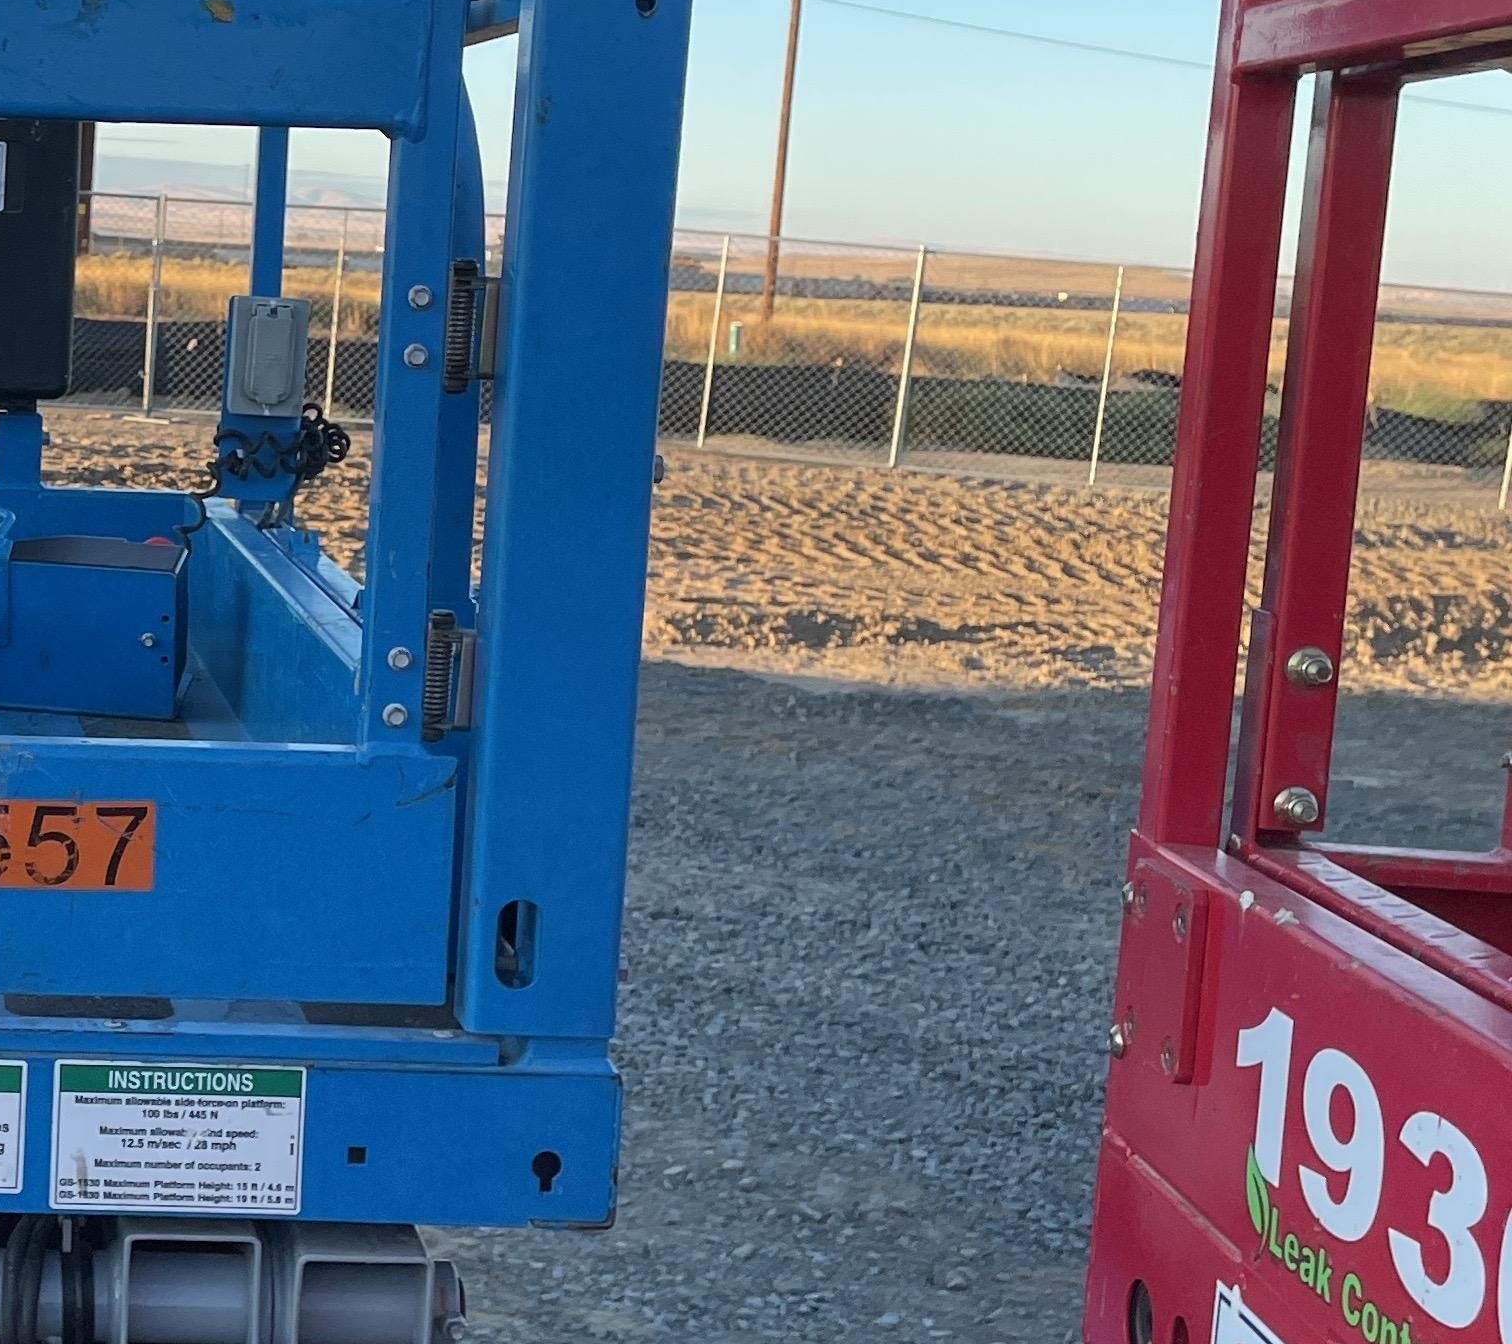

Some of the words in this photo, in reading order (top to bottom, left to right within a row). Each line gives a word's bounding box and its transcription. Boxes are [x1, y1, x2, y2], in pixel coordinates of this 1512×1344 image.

[108, 1070, 254, 1092] INSTRUCTIONS
[74, 1095, 122, 1105] Maximum
[125, 1096, 172, 1106] allowable
[174, 1097, 195, 1106] side
[142, 1109, 160, 1118] 100
[163, 1110, 178, 1119] lbs
[189, 1110, 207, 1119] 445
[210, 1111, 218, 1120] N
[99, 1126, 147, 1136] Maximum
[121, 1139, 144, 1149] 12.5
[147, 1140, 182, 1150] m/sec
[210, 1141, 237, 1152] mph
[94, 1158, 142, 1168] Maximum
[144, 1160, 182, 1170] number
[184, 1160, 196, 1170] of
[198, 1162, 252, 1172] occupants:
[254, 1162, 261, 1172] 2
[104, 1180, 150, 1188] Maximum
[154, 1180, 195, 1189] Platform
[104, 1192, 150, 1200] Maximum
[154, 1192, 194, 1201] Platform
[1269, 1206, 1333, 1304] Leak
